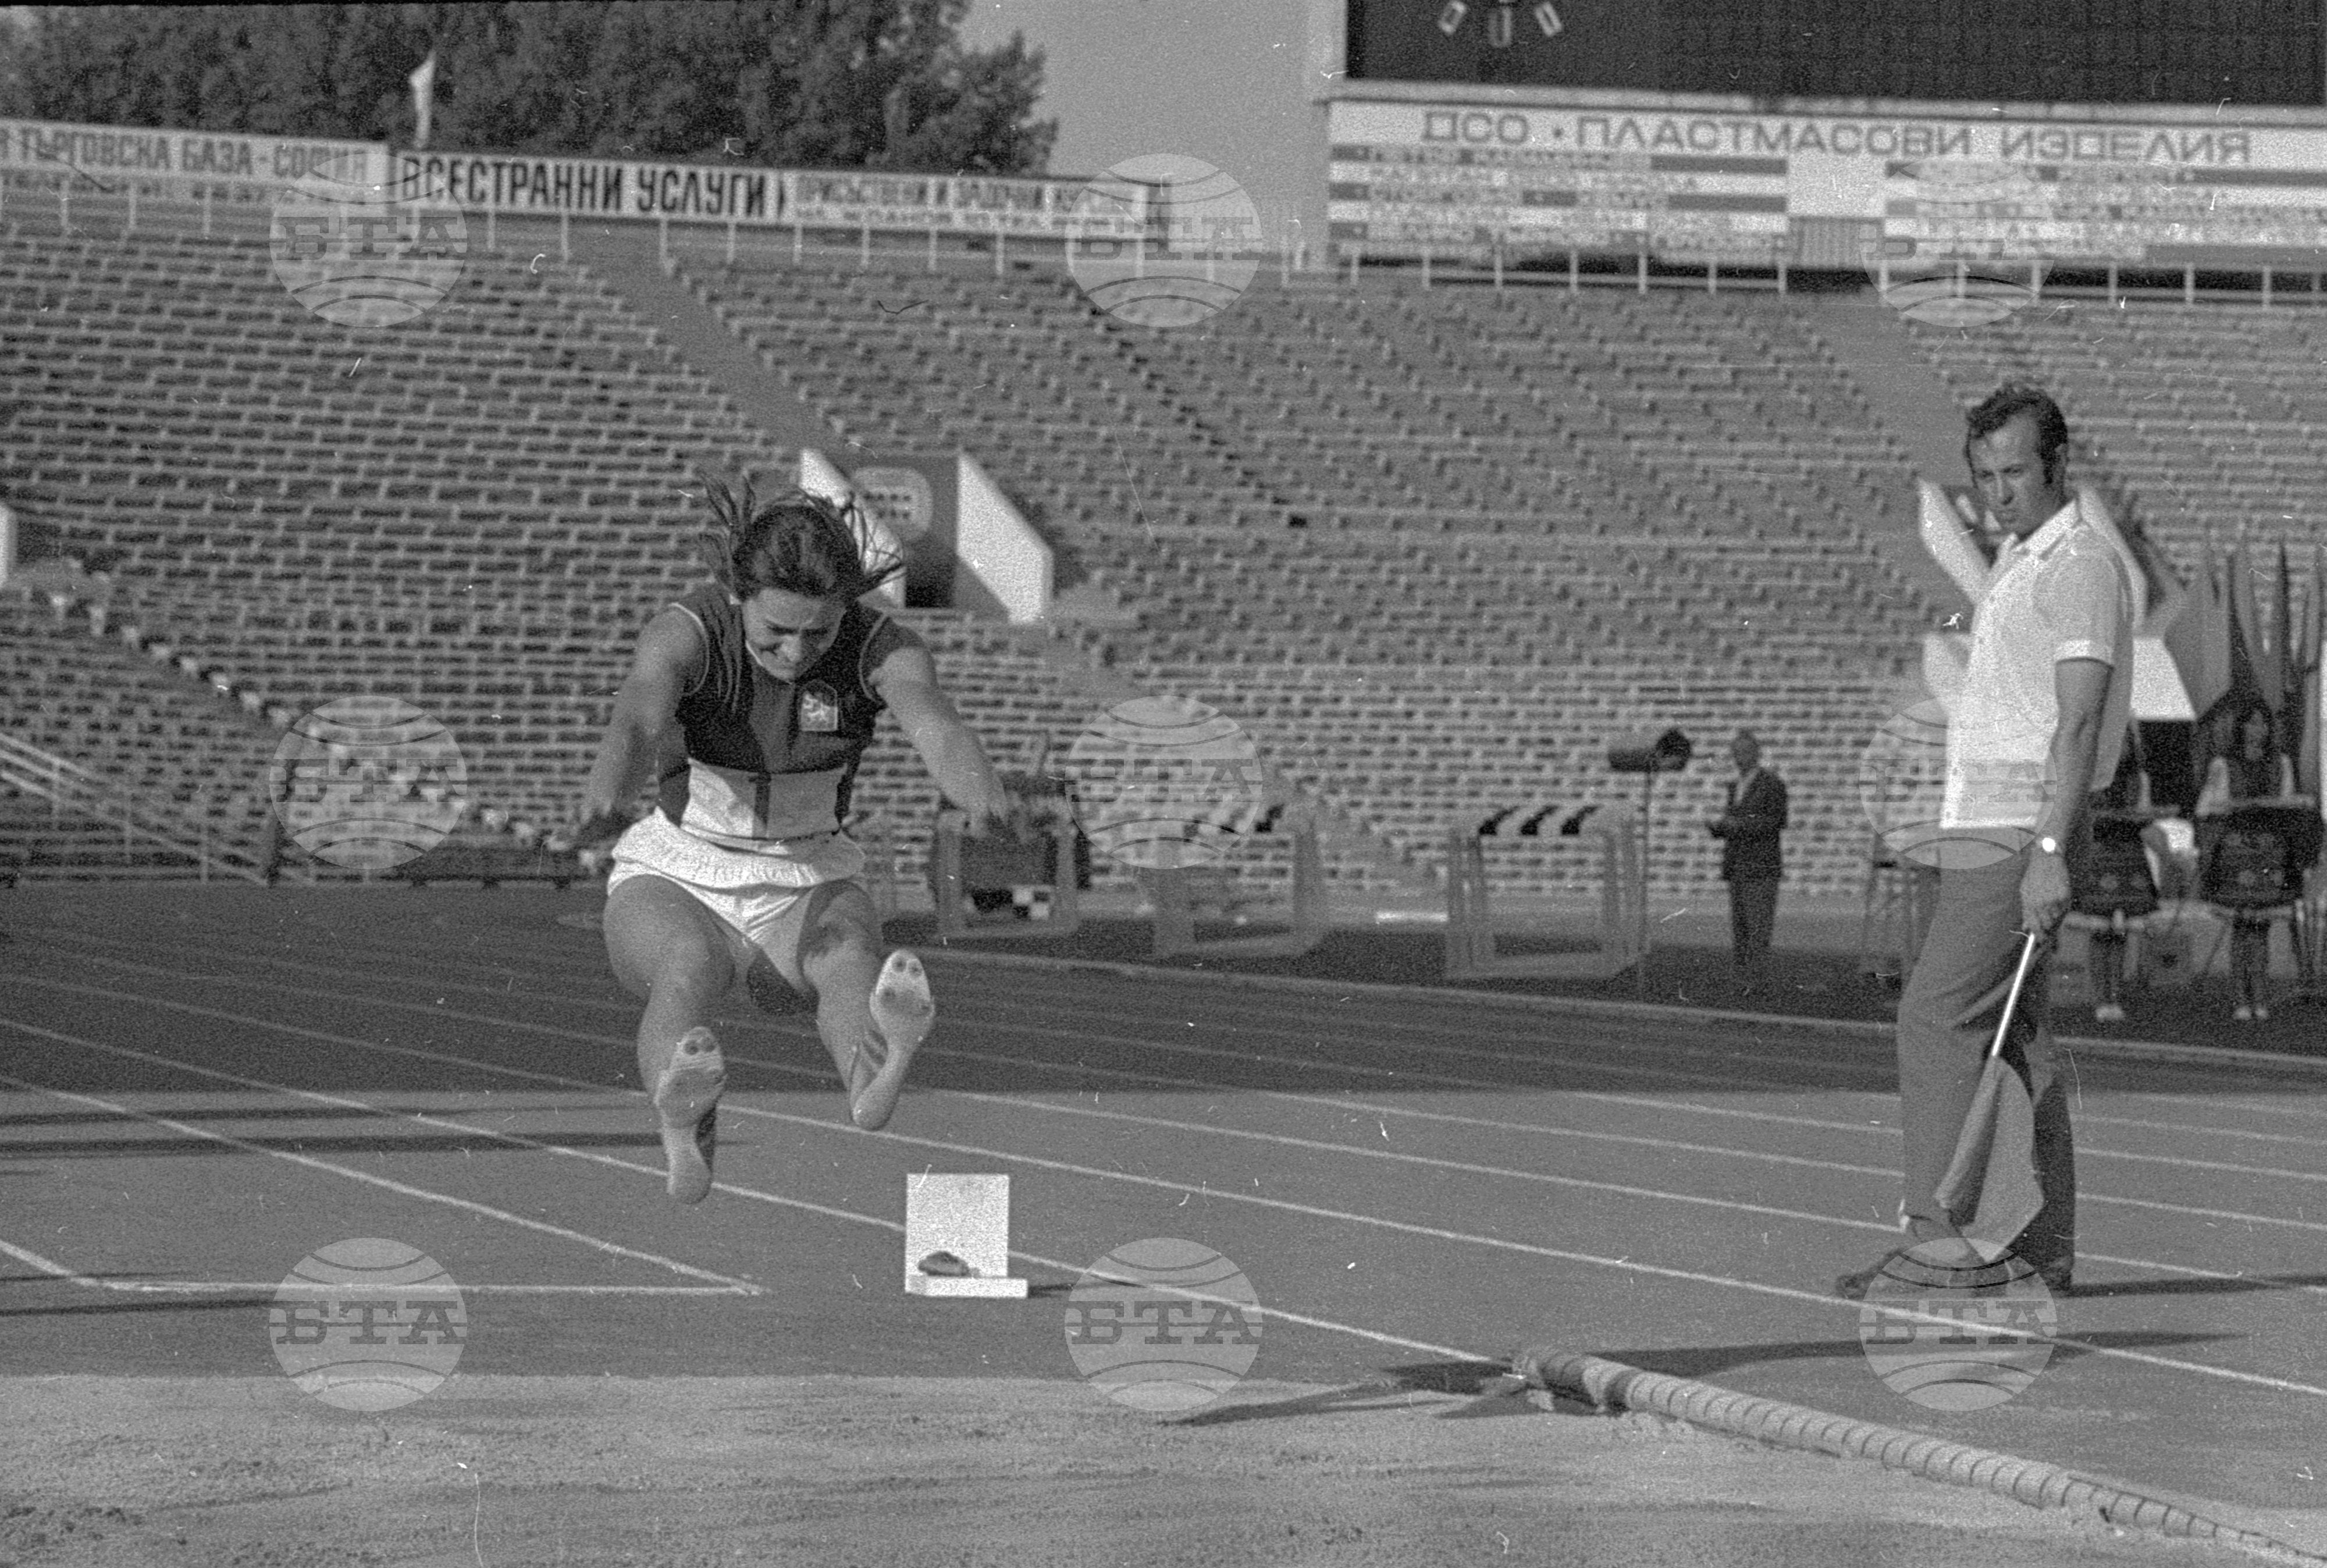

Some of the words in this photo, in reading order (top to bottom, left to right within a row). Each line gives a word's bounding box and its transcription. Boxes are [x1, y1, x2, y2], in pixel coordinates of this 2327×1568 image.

[181, 137, 252, 176] БАЗА
[273, 144, 367, 183] СОФИЯ
[1422, 111, 1530, 145] ДСО
[1577, 116, 1971, 155] ПЛАСТМАСОВИ
[1999, 127, 2251, 164] ИЗДЕЛИЯ
[401, 156, 622, 212] ВСЕСТРАННИ
[638, 169, 765, 218] УСЛУГИ
